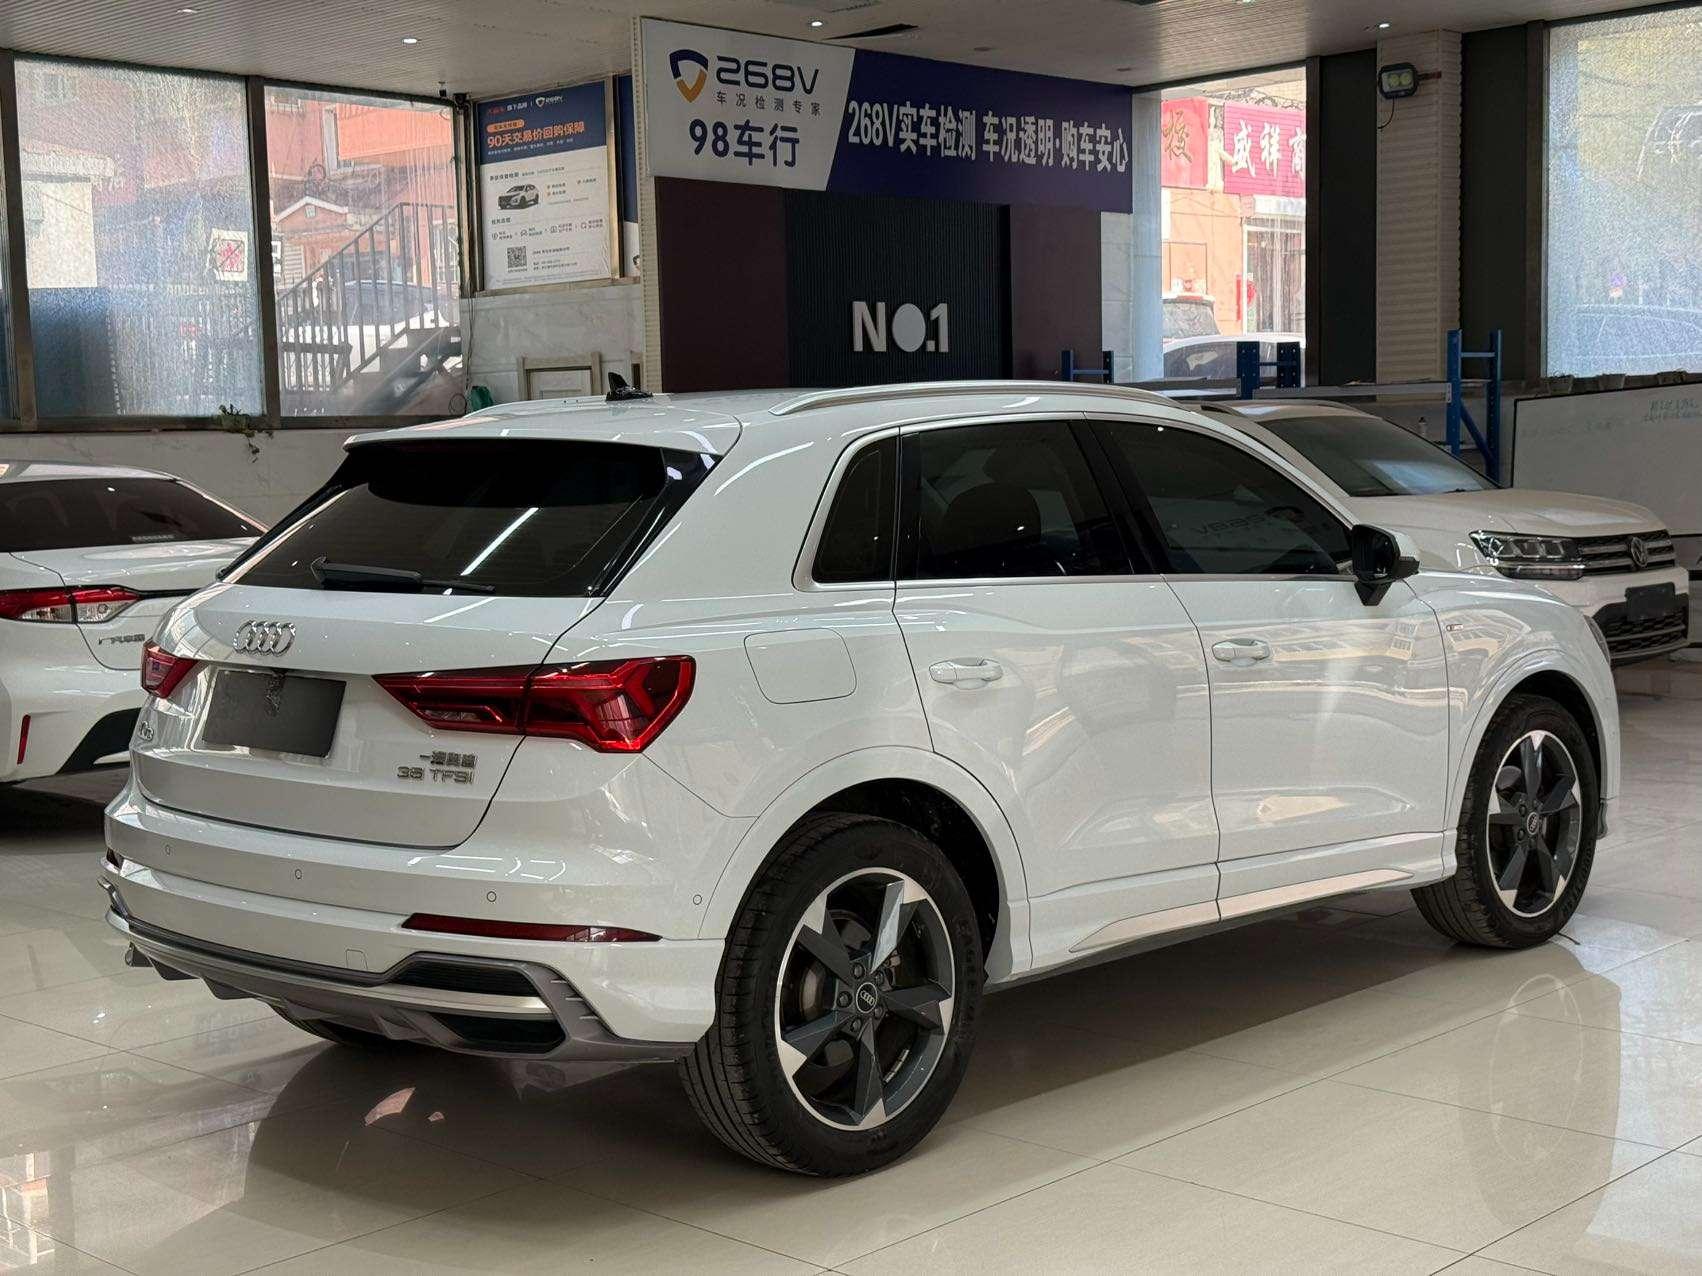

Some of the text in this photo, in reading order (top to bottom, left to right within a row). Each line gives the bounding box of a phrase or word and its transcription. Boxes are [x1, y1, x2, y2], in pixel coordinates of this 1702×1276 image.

[715, 55, 819, 95] 268V
[716, 90, 822, 116] 车况检测专家
[689, 118, 800, 167] 98车行
[848, 100, 976, 161] 268V实车检测
[982, 110, 1129, 174] 车况透明·购车安心
[852, 301, 949, 352] NO.1
